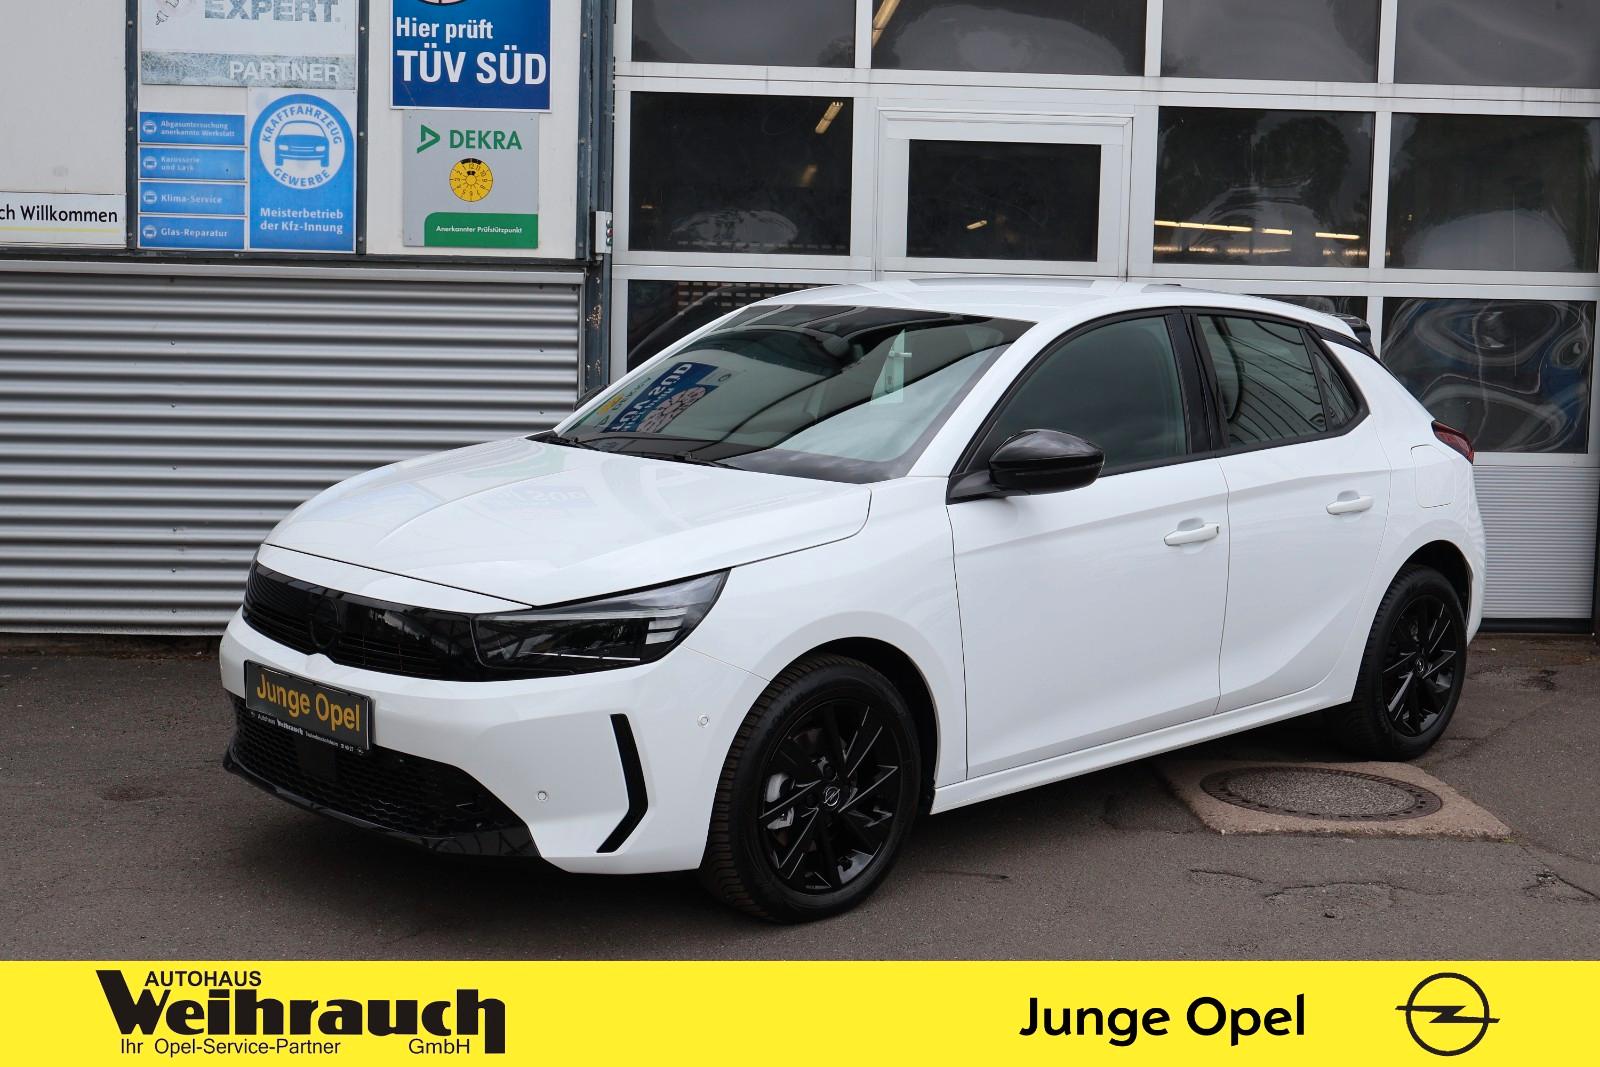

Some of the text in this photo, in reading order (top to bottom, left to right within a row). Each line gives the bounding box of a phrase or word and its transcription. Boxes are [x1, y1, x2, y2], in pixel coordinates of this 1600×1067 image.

[396, 17, 493, 43] Hier prüft
[229, 61, 340, 82] PARTNER
[397, 43, 546, 84] TÜV SÜD
[161, 120, 228, 130] Abgasuntersuchung
[262, 105, 342, 144] KRAFTFAHRZEUG
[449, 129, 522, 150] DEKRA
[273, 167, 331, 187] GEWERBE
[161, 194, 222, 204] Klima-Service
[20, 204, 118, 223] Willkommen
[260, 207, 344, 219] Meisterbetrieb
[161, 227, 228, 238] Glas-Reparatur
[260, 220, 343, 234] der Kfz-Innung
[436, 225, 523, 235] Anerkannter Prüfstützpunkt
[256, 673, 360, 732] Junge Opel
